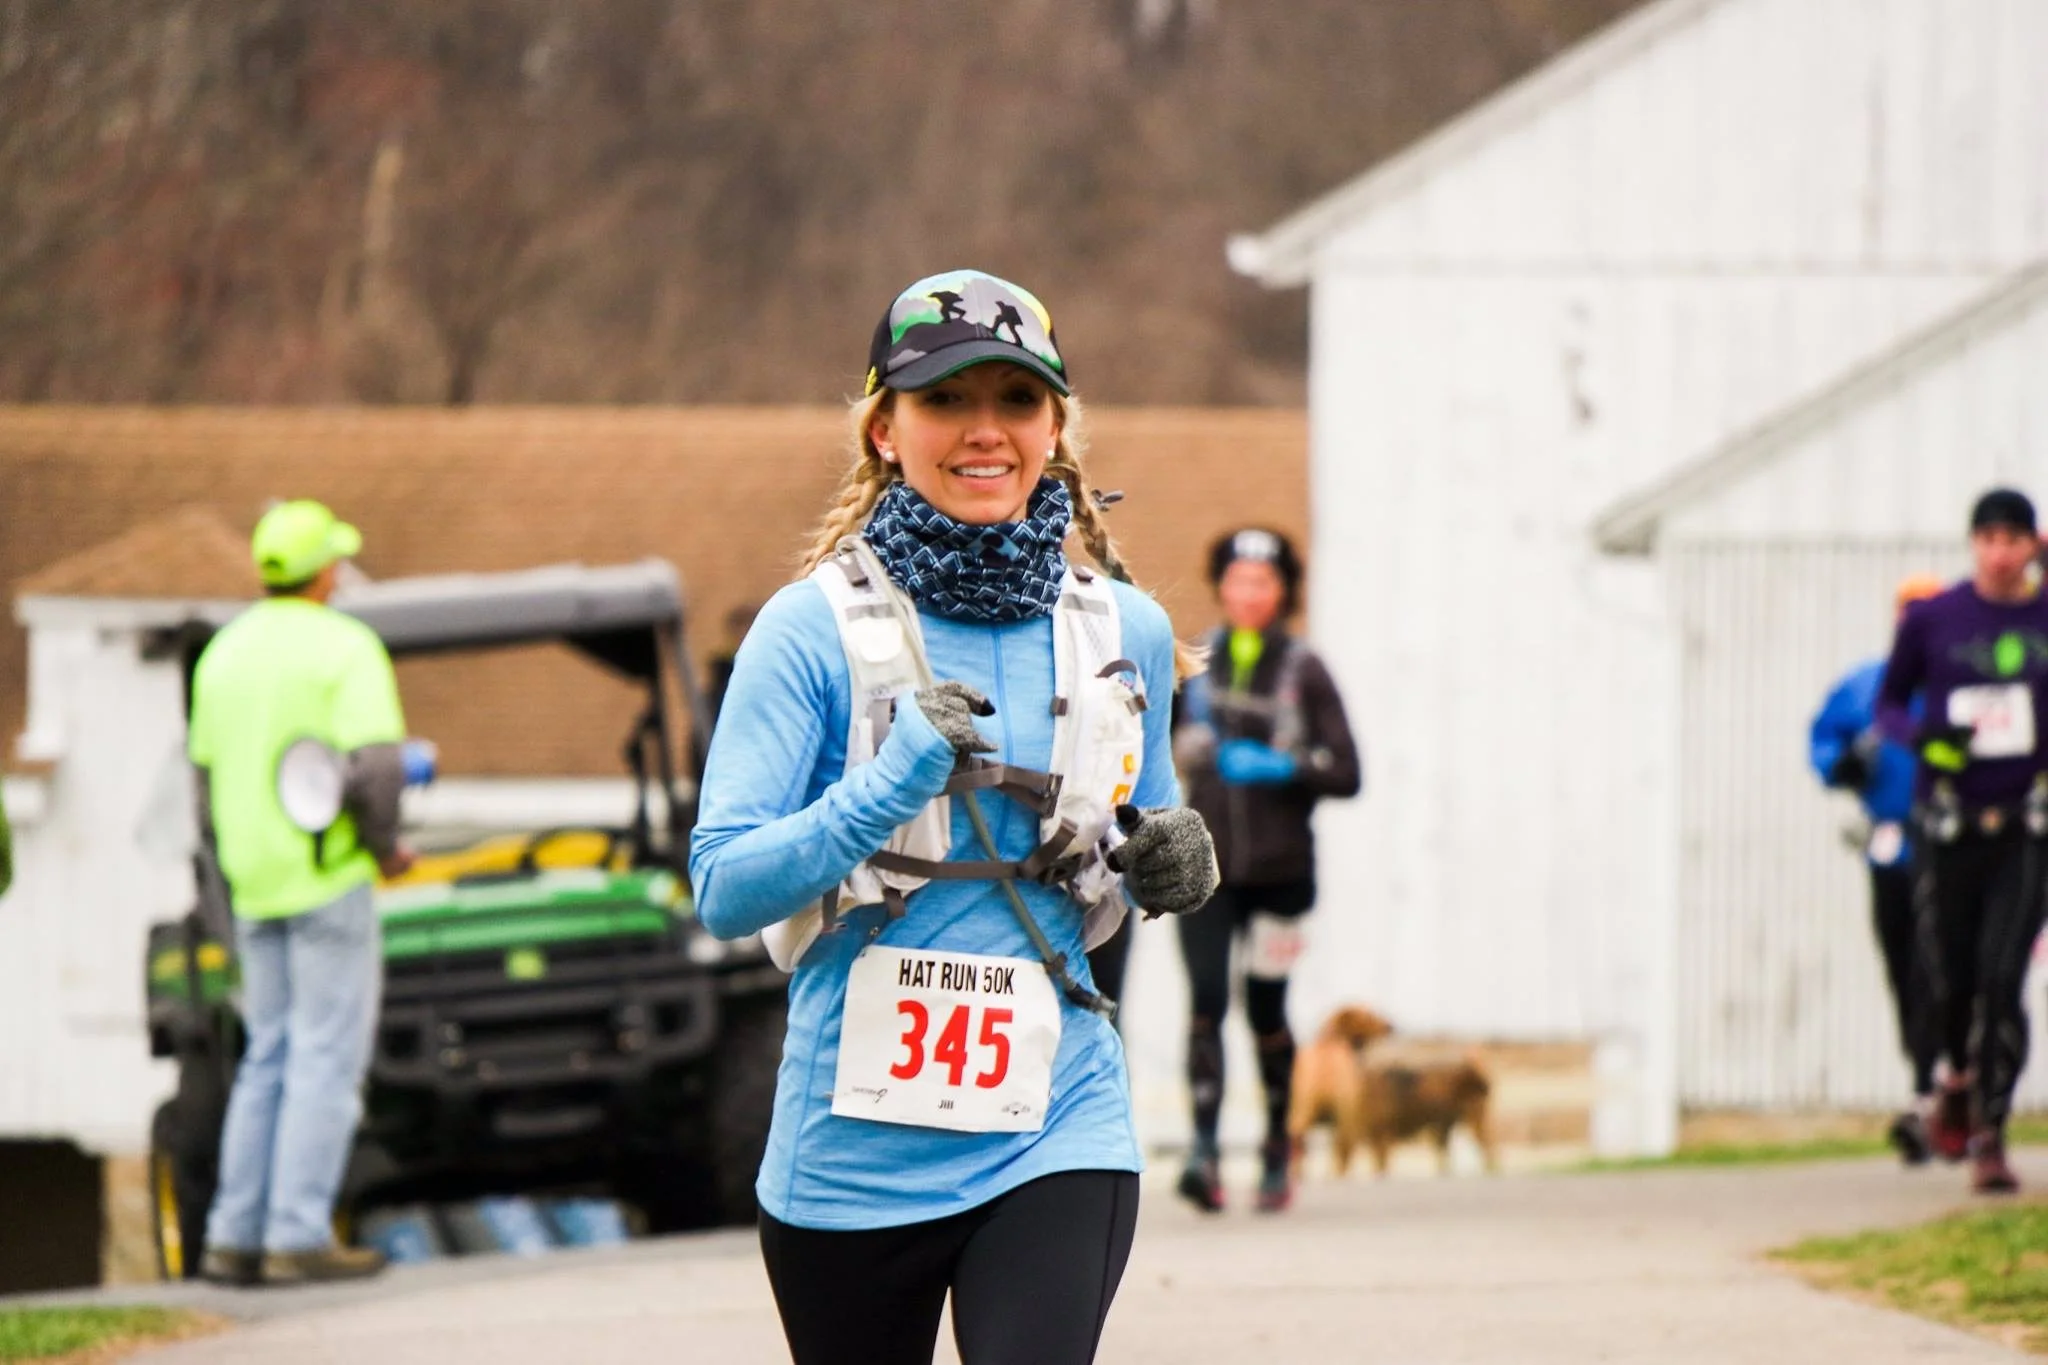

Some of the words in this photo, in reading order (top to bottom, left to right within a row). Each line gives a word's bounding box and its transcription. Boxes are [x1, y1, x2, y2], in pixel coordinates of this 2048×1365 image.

[898, 958, 936, 988] HAT
[940, 962, 976, 992] RUN
[983, 966, 1015, 994] 50K
[889, 1000, 1013, 1089] 345
